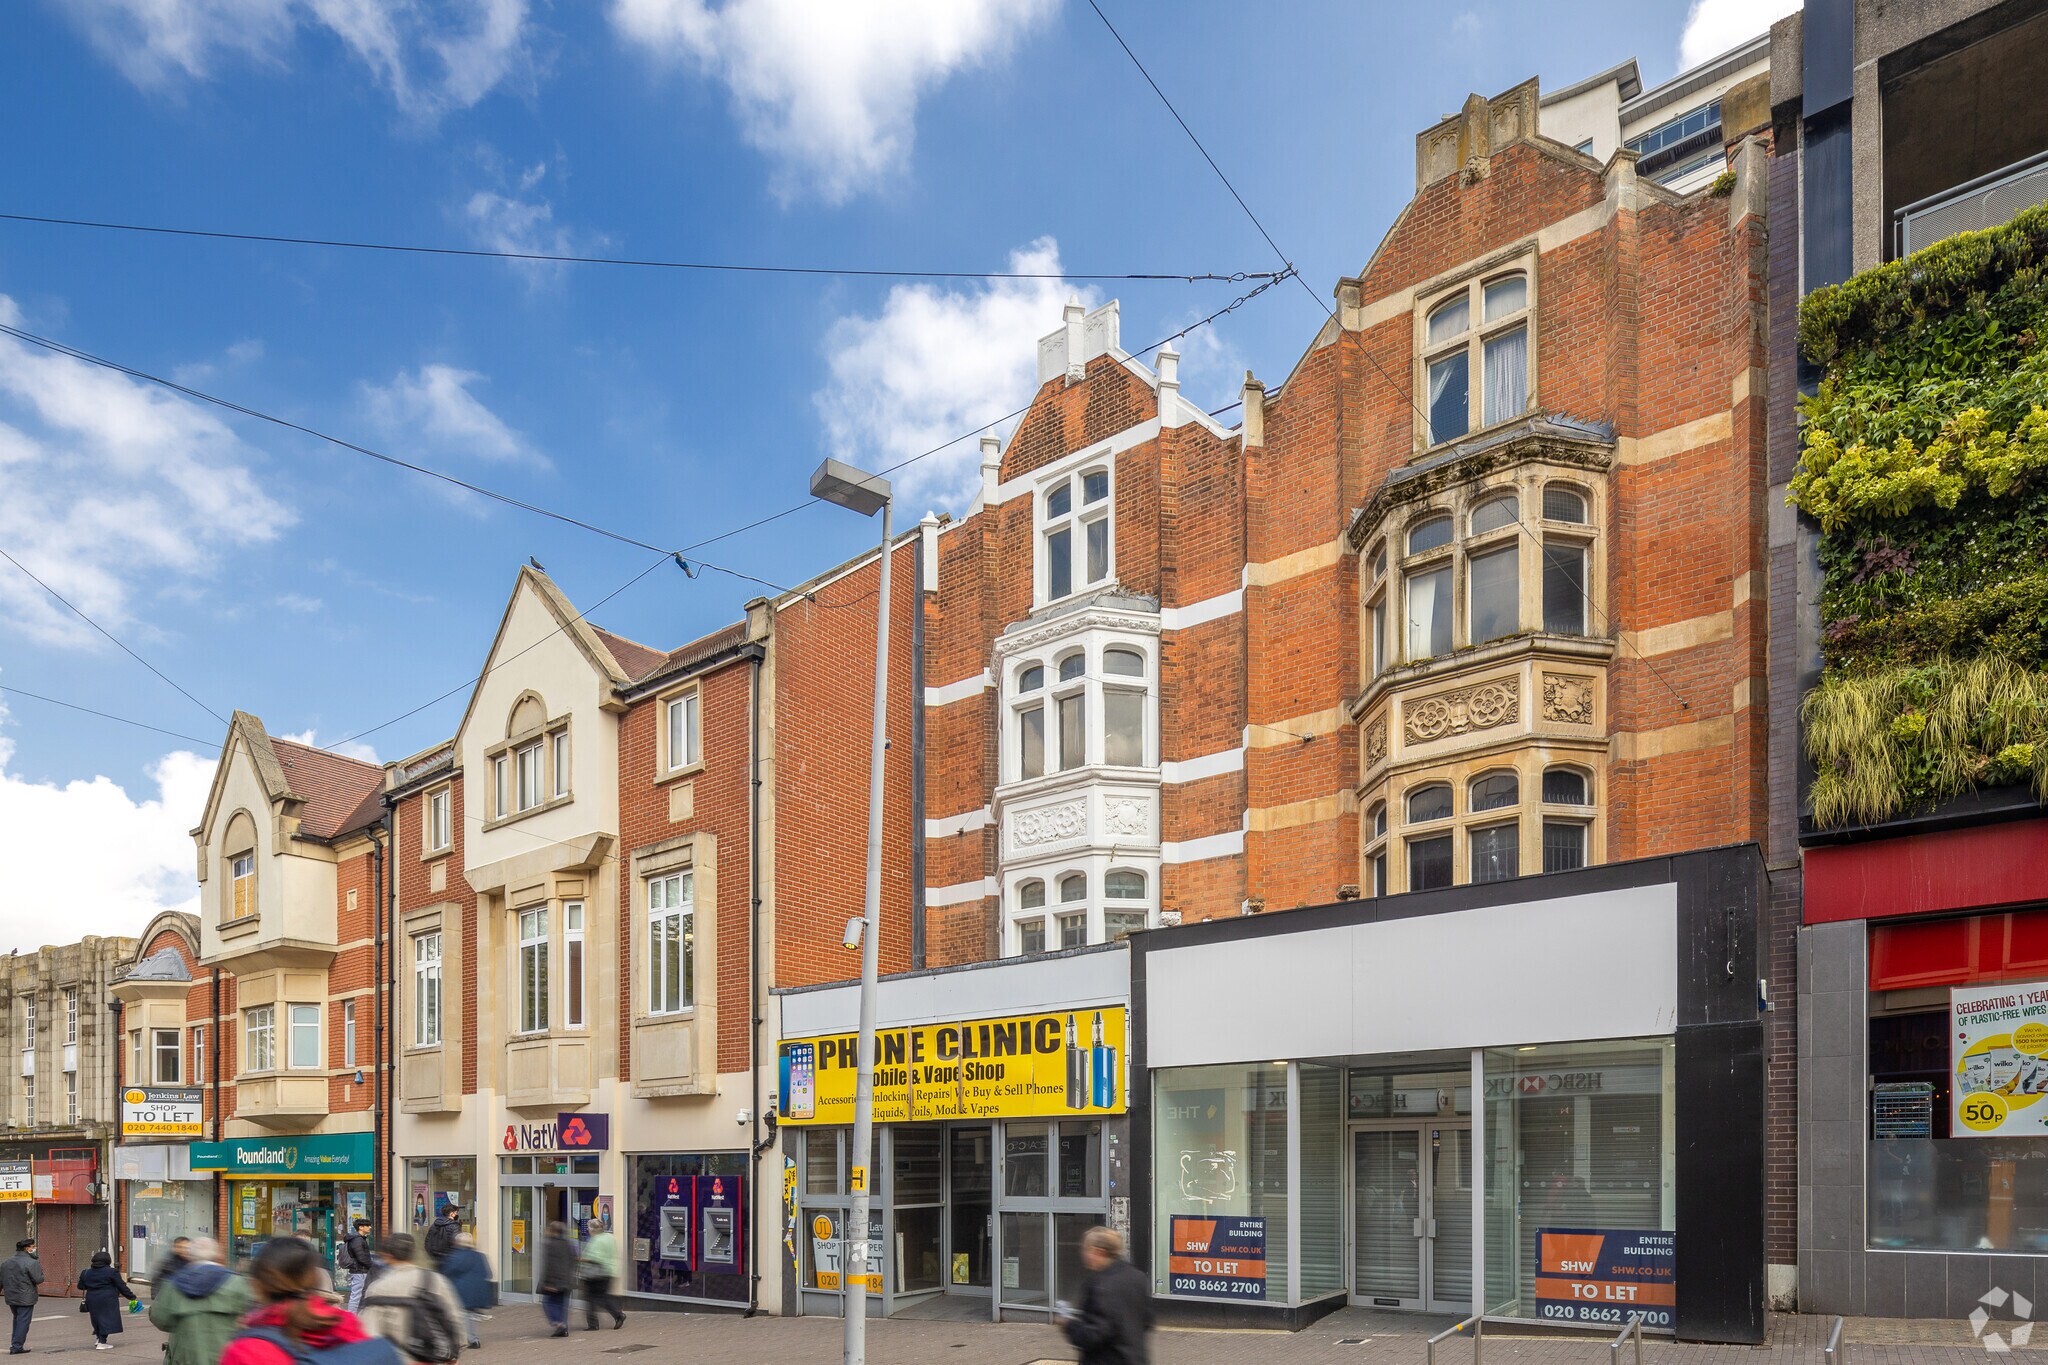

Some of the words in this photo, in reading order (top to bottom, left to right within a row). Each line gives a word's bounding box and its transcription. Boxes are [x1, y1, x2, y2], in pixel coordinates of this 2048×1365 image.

[1956, 995, 2016, 1015] CELEBRATING
[2018, 994, 2024, 1006] 1
[1958, 1016, 1968, 1027] OF
[1970, 1009, 2021, 1025] PLASTIC-FREE
[2022, 1004, 2047, 1017] WIPES
[936, 1018, 1061, 1061] CLINIC
[873, 1067, 907, 1086] obile
[912, 1069, 920, 1085] &
[965, 1061, 1005, 1081] Shop
[148, 1092, 179, 1101] Jenkins
[916, 1088, 950, 1103] Repairs
[973, 1086, 991, 1100] Buy
[994, 1085, 1002, 1096] &
[1004, 1083, 1023, 1096] Sell
[1025, 1083, 1064, 1095] Phones
[133, 1111, 156, 1122] TO
[163, 1112, 194, 1122] LET
[935, 1103, 957, 1115] Mod
[970, 1103, 999, 1117] Vapes
[236, 1146, 285, 1165] Poundland
[816, 1221, 831, 1235] JL
[1239, 1221, 1263, 1229] ENTIRE
[817, 1241, 836, 1250] SHOP
[1186, 1241, 1209, 1251] SHW
[1220, 1245, 1262, 1254] SHW.CO.UK
[1639, 1236, 1674, 1245] ENTIRE
[1623, 1247, 1674, 1256] BUILDING
[1193, 1260, 1212, 1273] TO
[1216, 1261, 1239, 1275] LET
[1560, 1260, 1594, 1272] SHW
[1611, 1266, 1672, 1276] SHW.CO.UK
[820, 1275, 838, 1286] 020
[1175, 1278, 1196, 1290] 020
[1199, 1280, 1228, 1292] 8662
[1231, 1282, 1260, 1294] 2700
[1571, 1283, 1599, 1299] TO
[1605, 1285, 1638, 1301] LET
[1544, 1304, 1575, 1319] 020
[1580, 1307, 1621, 1322] 8662
[1626, 1310, 1670, 1325] 2700
